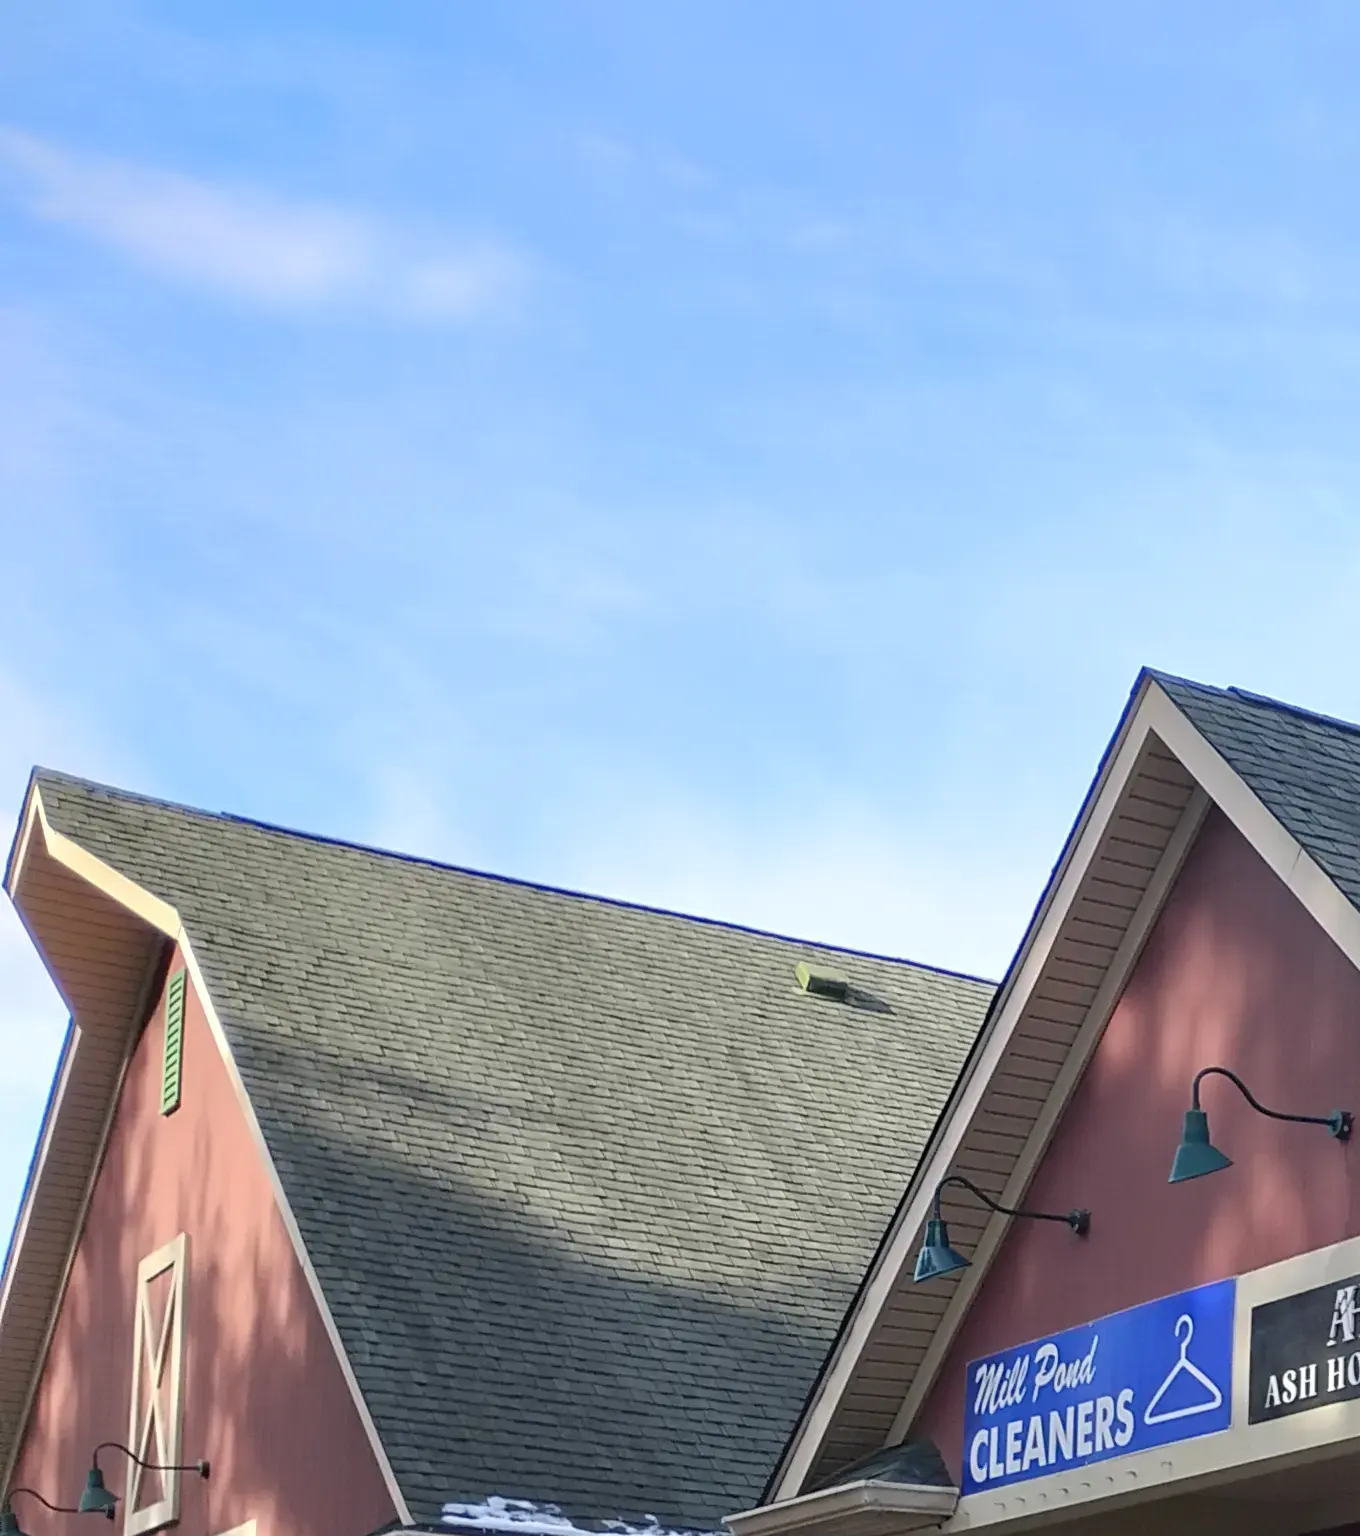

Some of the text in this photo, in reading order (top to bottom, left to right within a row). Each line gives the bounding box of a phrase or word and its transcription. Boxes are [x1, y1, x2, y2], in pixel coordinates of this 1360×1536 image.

[974, 1335, 1098, 1415] Mill Pond
[1264, 1363, 1318, 1408] ASH
[970, 1388, 1134, 1483] CLEANERS
